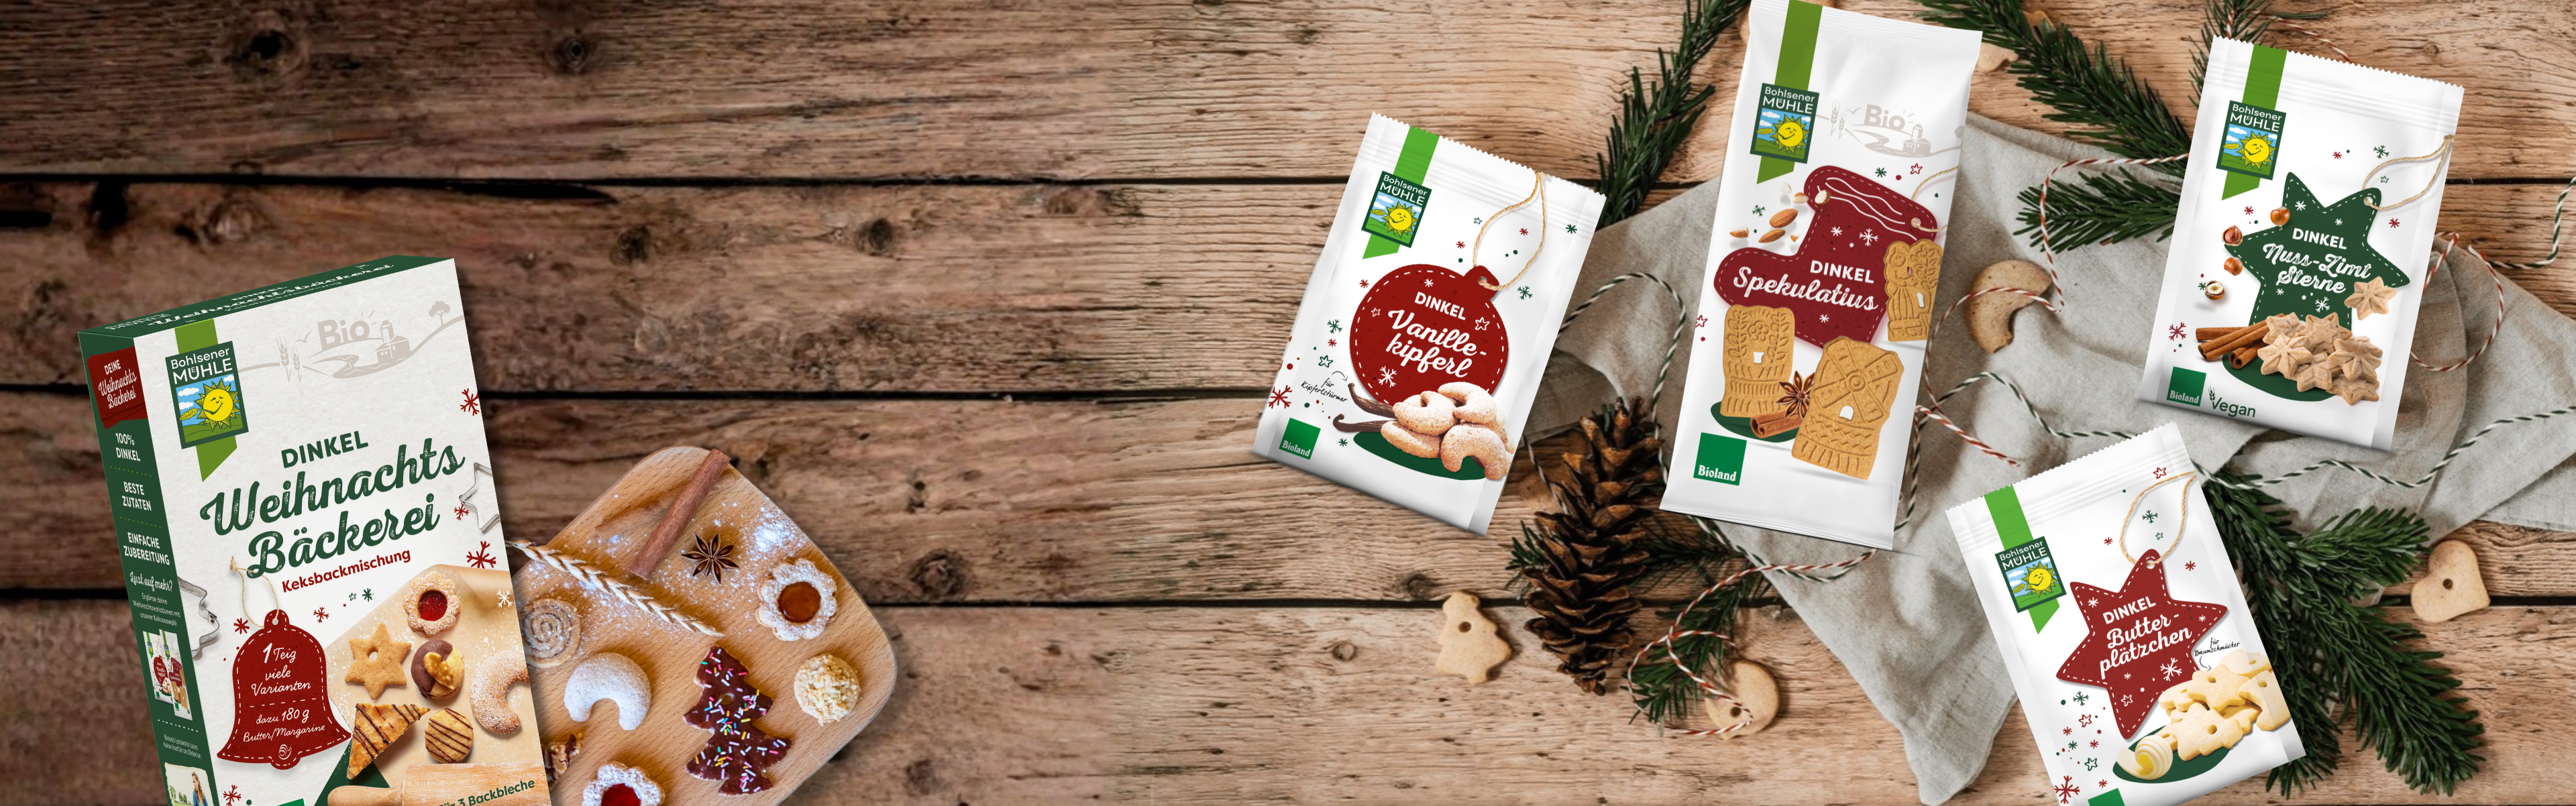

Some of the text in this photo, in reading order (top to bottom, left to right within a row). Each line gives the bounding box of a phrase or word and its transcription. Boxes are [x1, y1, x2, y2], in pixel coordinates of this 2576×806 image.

[1764, 87, 1815, 103] Bohlsener
[1864, 104, 1905, 130] Bio
[2232, 103, 2282, 121] Bohlsener
[1383, 174, 1428, 196] Bohlsener
[2292, 227, 2347, 250] DINKEL
[2263, 243, 2371, 279] Nuss-Zimt
[1810, 260, 1874, 284] DINKEL
[2275, 266, 2347, 294] Sterne
[1733, 266, 1878, 310] Spekulatius
[1414, 291, 1466, 321] DINKEL
[317, 319, 370, 350] Bio
[1388, 309, 1487, 356] Vanille-
[170, 348, 229, 369] Bohlsener
[1385, 333, 1472, 378] kipferl
[104, 359, 121, 375] DEINE
[98, 369, 138, 396] Weihnachts
[1301, 380, 1348, 402] Kipferlstürmer
[1321, 378, 1334, 388] für
[107, 386, 137, 409] Bäckerei
[2169, 390, 2200, 404] Bioland
[2212, 397, 2256, 418] Vegan
[115, 433, 135, 446] 100%
[281, 430, 369, 469] DINKEL
[1282, 440, 1311, 457] Bioland
[115, 447, 141, 461] DINKEL
[1698, 465, 1737, 481] Bioland
[123, 481, 145, 496] BESTE
[199, 437, 466, 536] Weihnachts
[121, 496, 152, 512] ZUTATEN
[127, 532, 160, 549] EINFACHE
[246, 493, 441, 579] Bäckerei
[123, 545, 170, 565] ZUBEREITUNG
[1999, 540, 2043, 561] Bohlsener
[129, 571, 172, 591] Lust auf mehr?
[282, 549, 411, 593] Keksbackmischung
[2102, 596, 2156, 624] DINKEL
[263, 642, 297, 664] 1 Teig
[2194, 641, 2240, 657] Baumschmücker
[2210, 637, 2220, 648] für
[2100, 628, 2192, 680] plätzchen
[265, 665, 291, 681] viele
[251, 680, 311, 696] Varianten
[256, 707, 309, 724] dazu 180 g
[243, 724, 325, 742] Butter/Margarine
[468, 780, 535, 806] Backbleche
